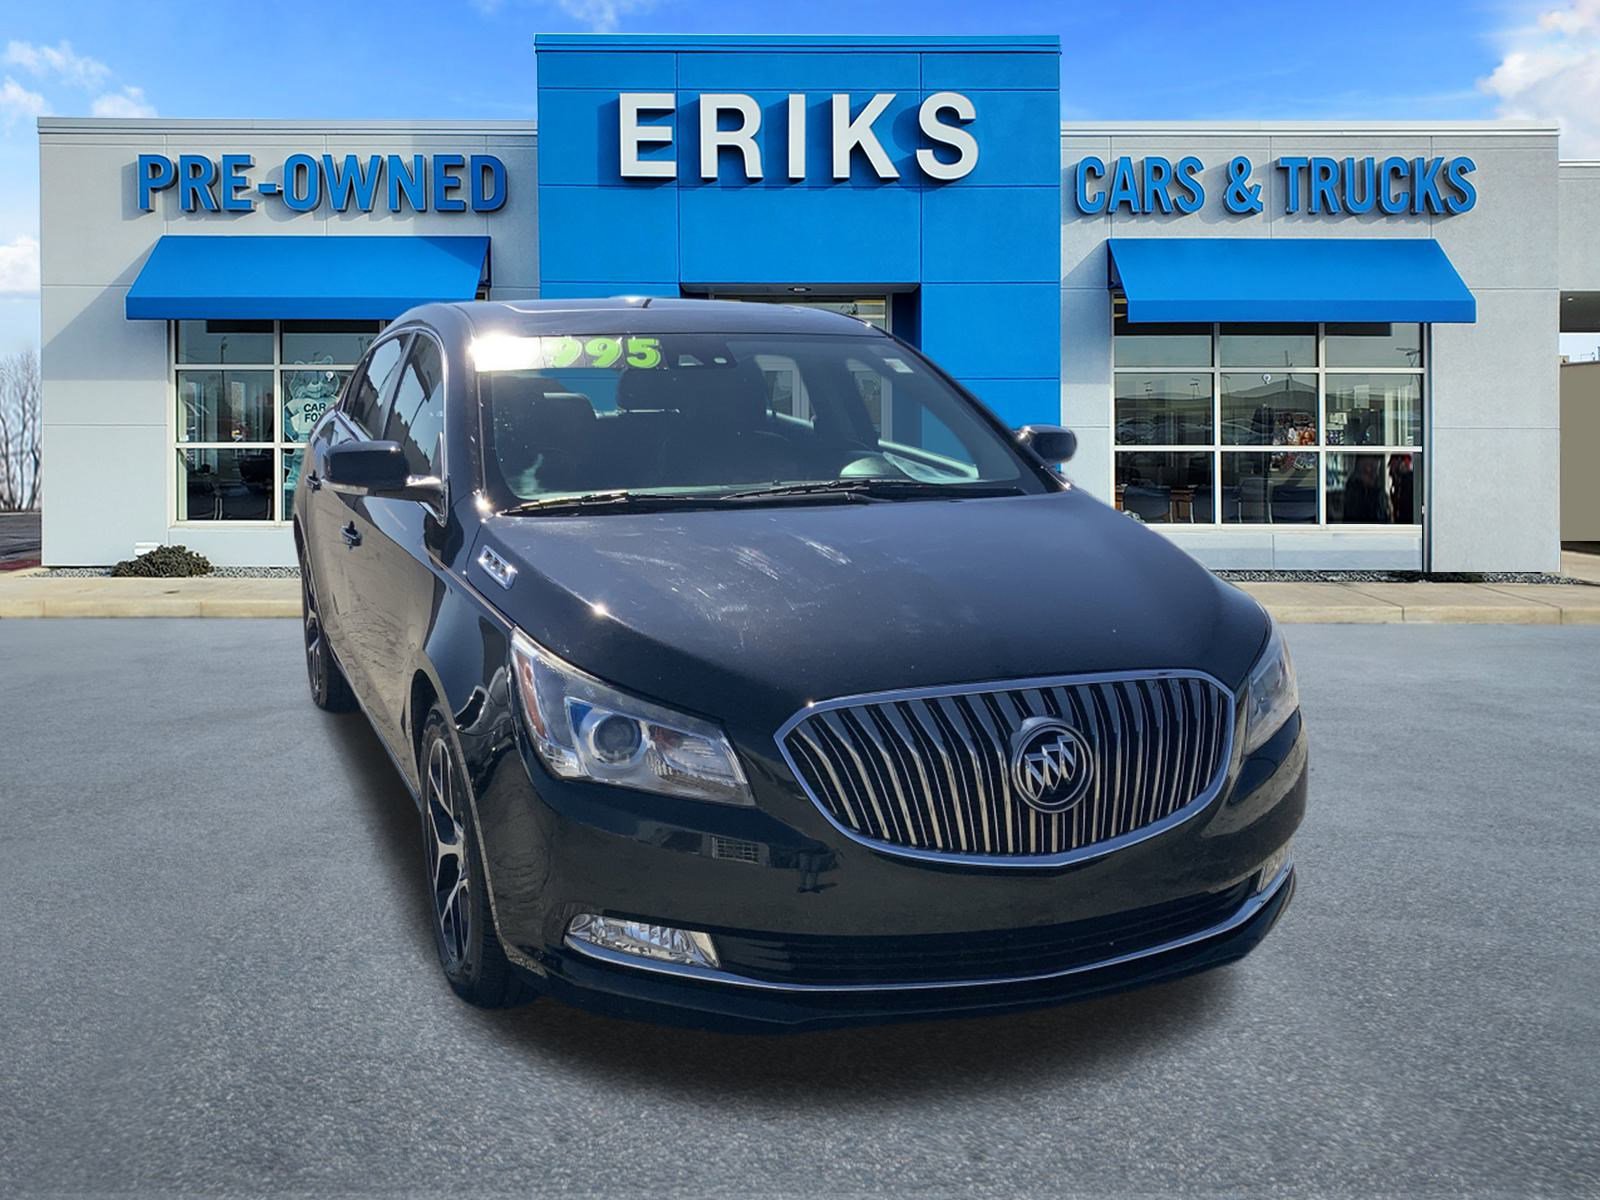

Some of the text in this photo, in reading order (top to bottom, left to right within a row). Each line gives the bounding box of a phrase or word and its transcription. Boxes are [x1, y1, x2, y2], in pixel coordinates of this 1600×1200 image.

[618, 91, 979, 181] ERIKS
[137, 153, 508, 213] PRE-OWNED
[1074, 156, 1478, 215] CARS & TRUCKS
[540, 334, 662, 369] 995
[303, 403, 327, 413] CAR
[304, 412, 321, 423] FO
